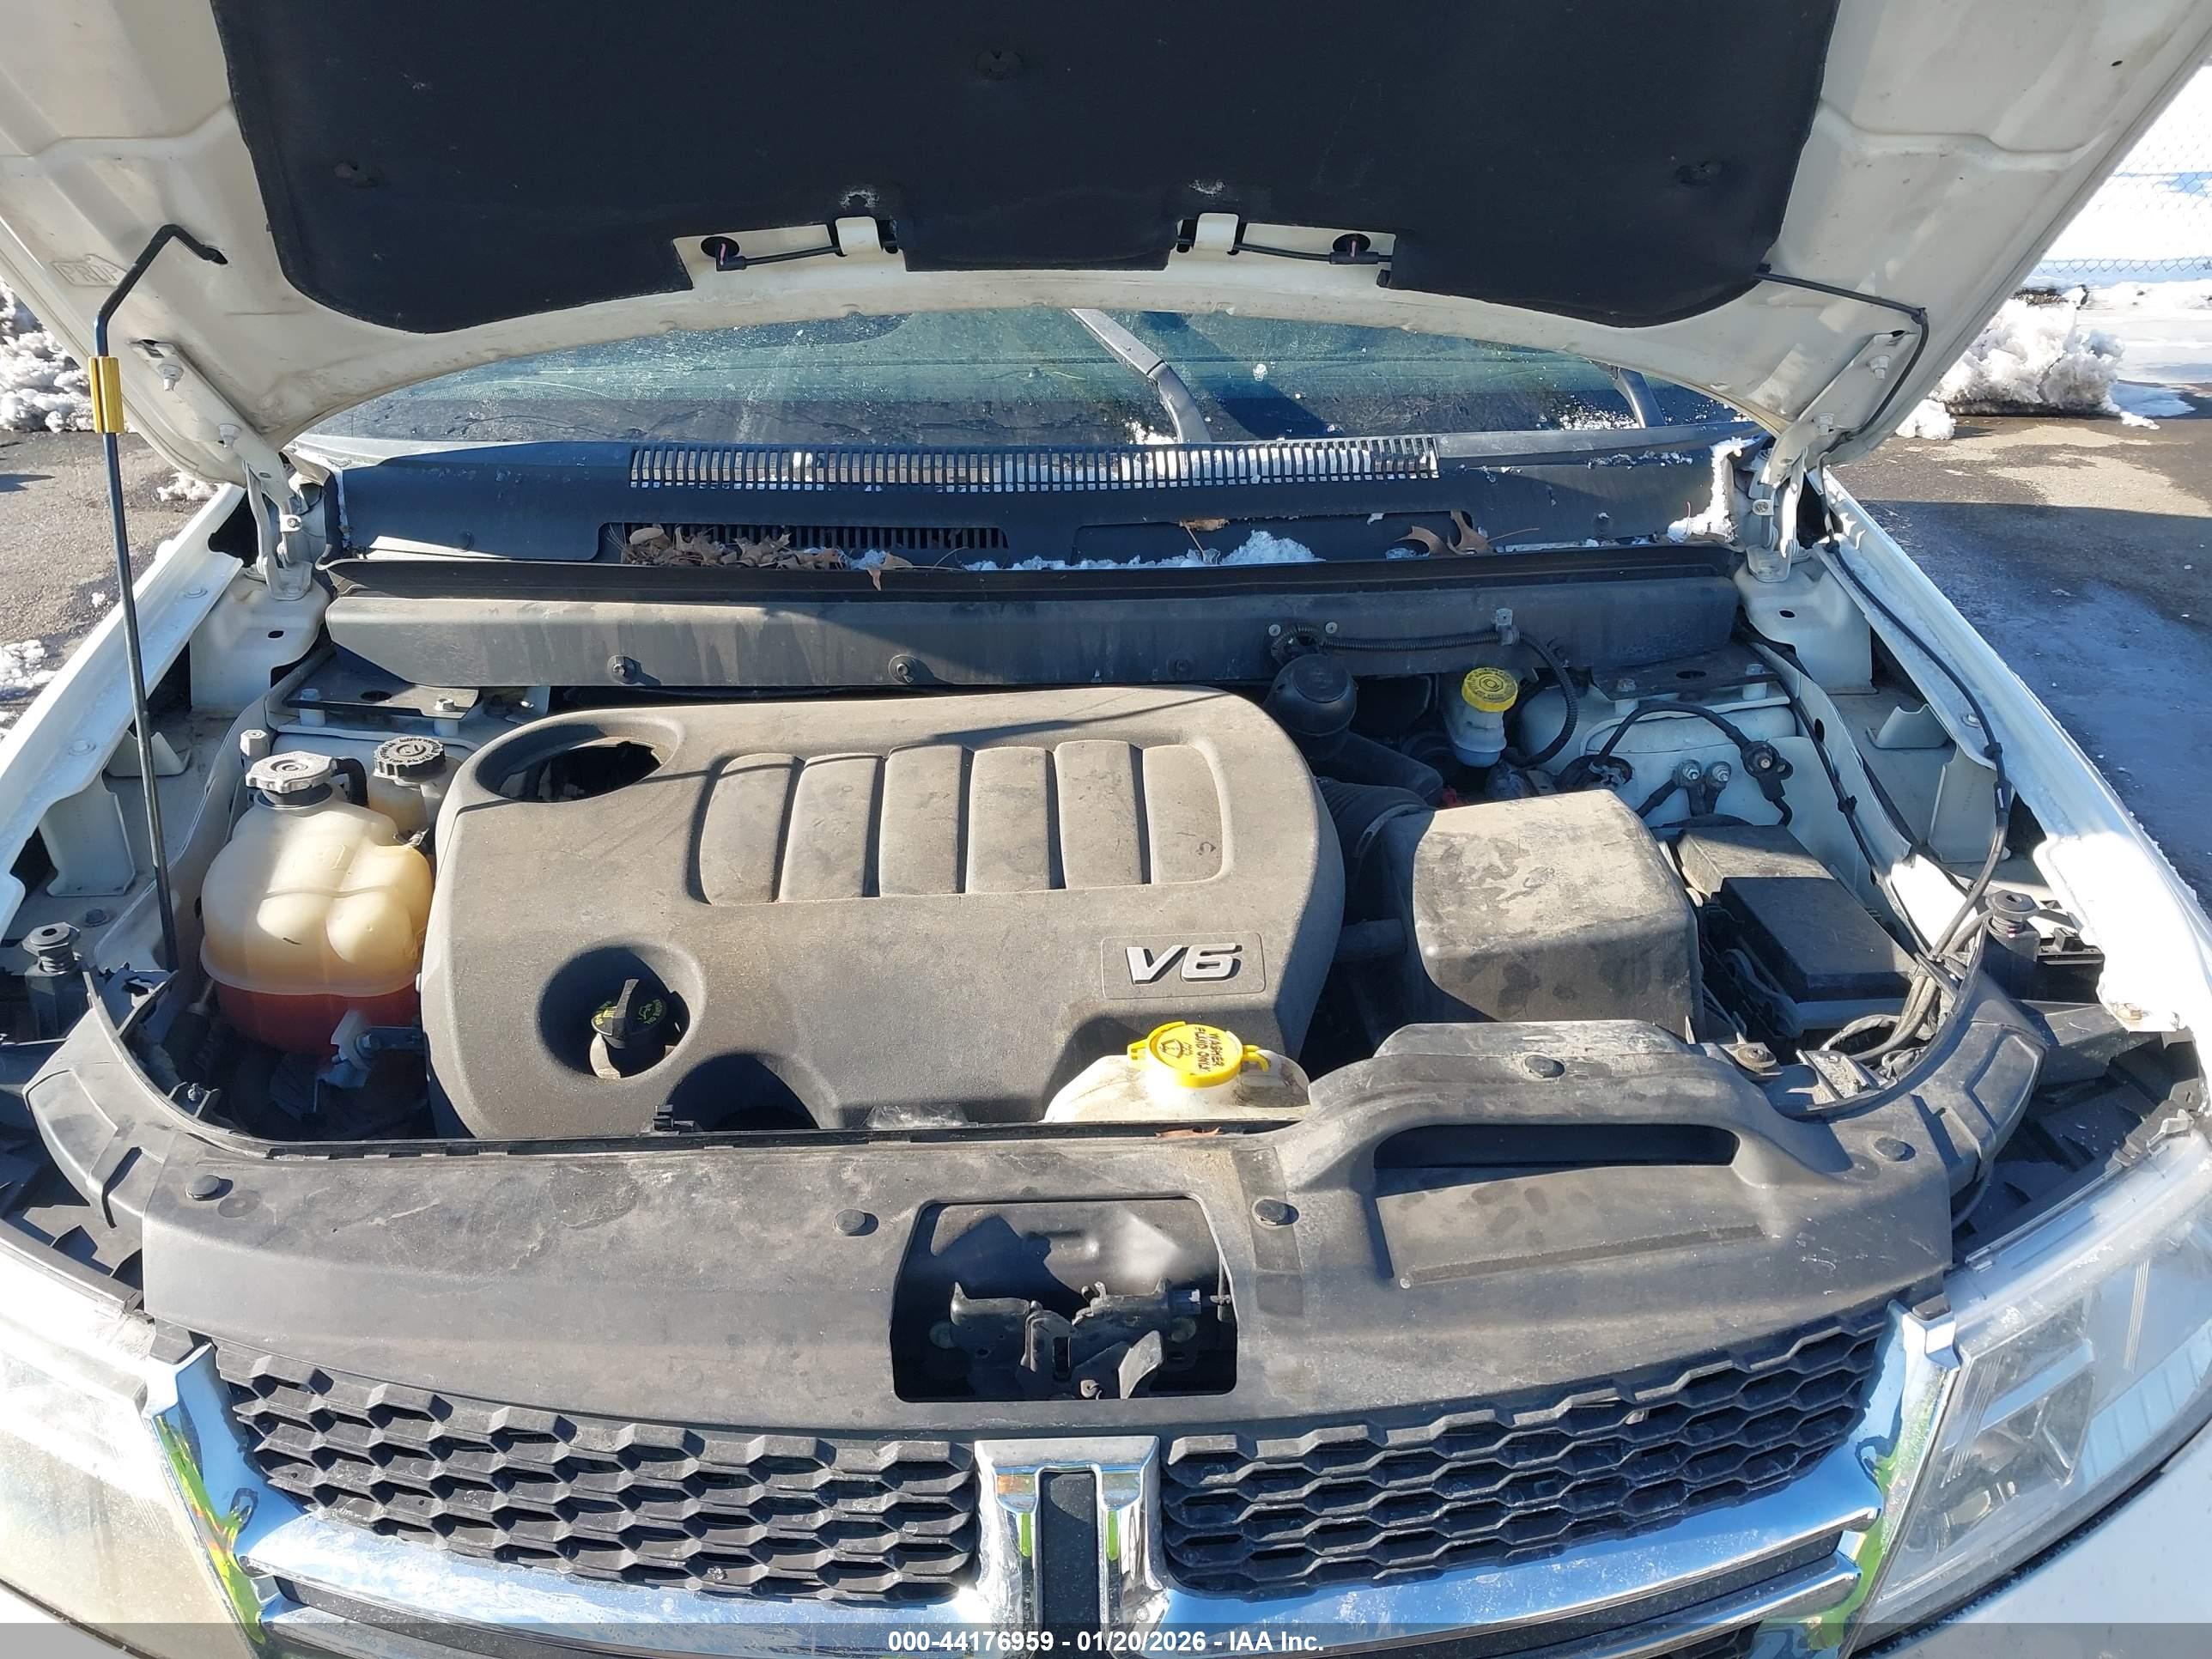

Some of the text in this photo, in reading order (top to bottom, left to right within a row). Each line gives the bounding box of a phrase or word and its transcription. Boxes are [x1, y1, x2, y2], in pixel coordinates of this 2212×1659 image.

[1126, 943, 1239, 984] V6
[1194, 1027, 1211, 1073] FLUID ONLY
[1208, 1033, 1225, 1066] WASHER
